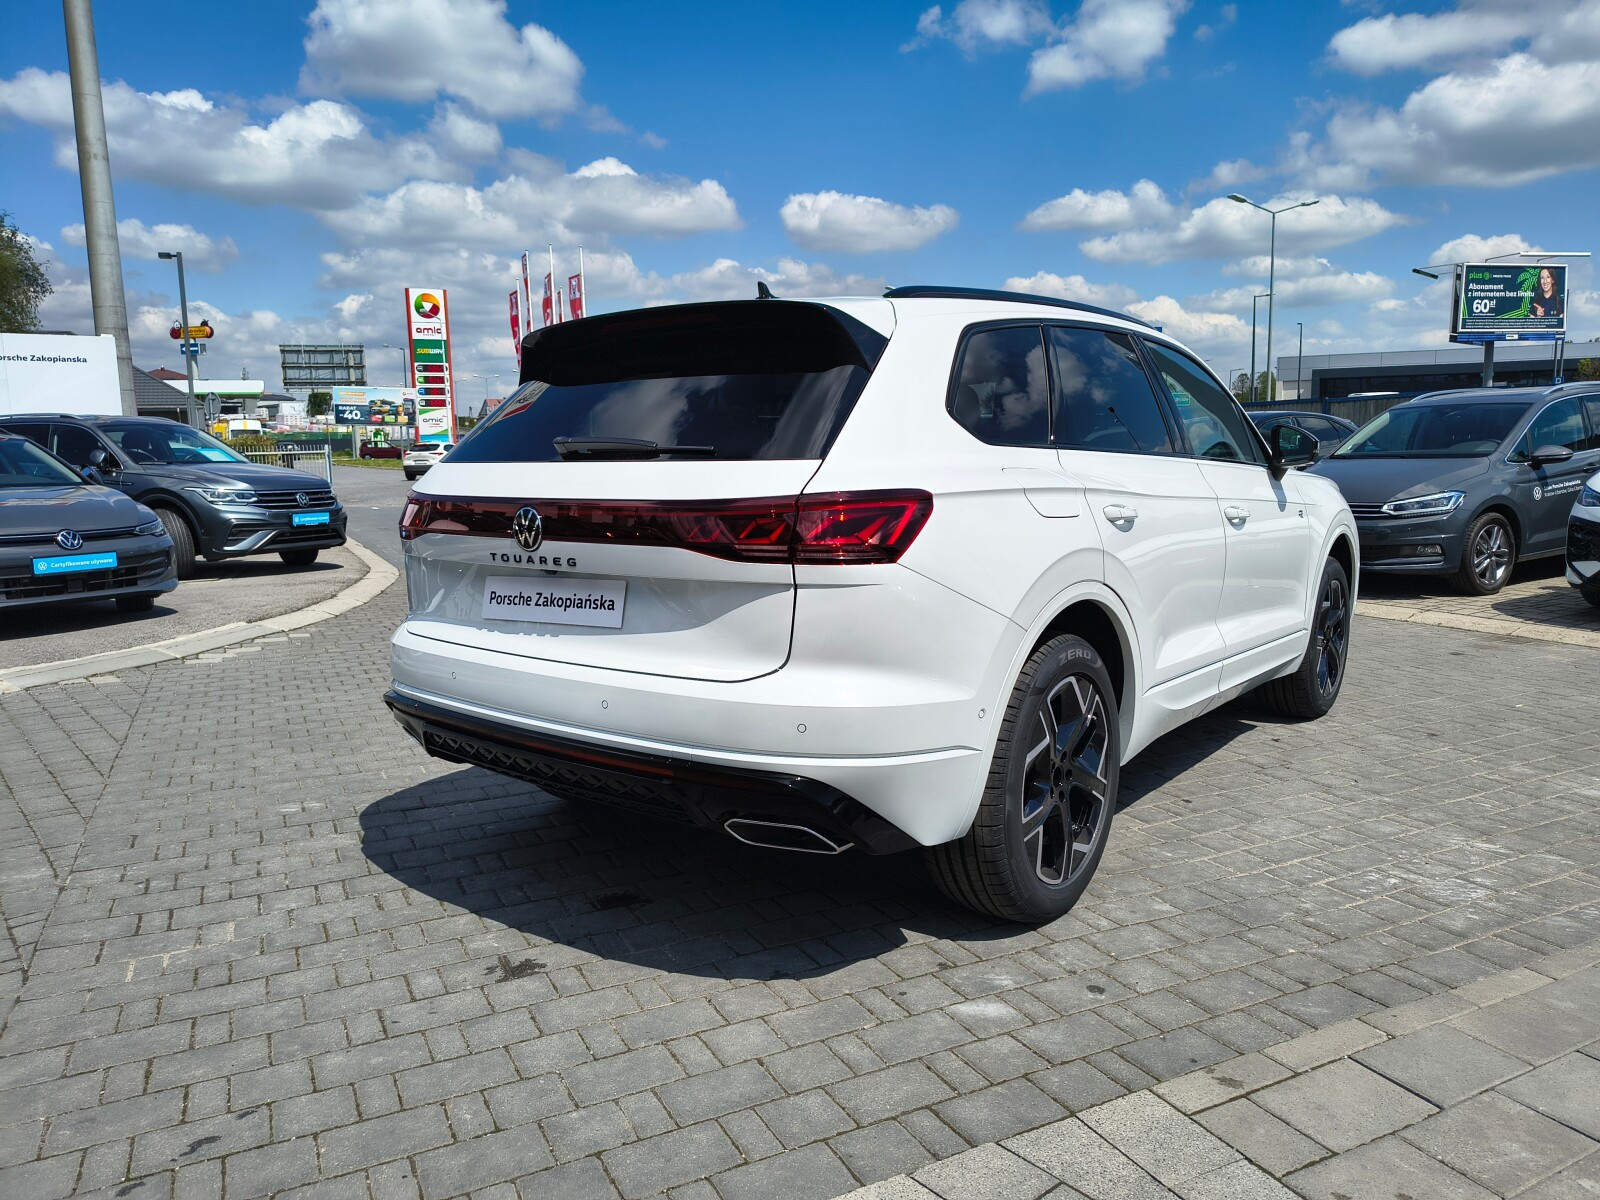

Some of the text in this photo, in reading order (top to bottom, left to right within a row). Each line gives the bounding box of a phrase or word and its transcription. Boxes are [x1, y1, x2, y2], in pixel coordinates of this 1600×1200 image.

[1469, 272, 1482, 280] plus
[1473, 299, 1490, 313] 60
[416, 326, 442, 334] amic
[339, 410, 361, 420] -40
[50, 558, 113, 568] Certyfikowane używane
[489, 552, 577, 567] TOUAREG
[489, 590, 616, 612] Porsche Zakopiańska
[1058, 649, 1091, 667] ZERO
